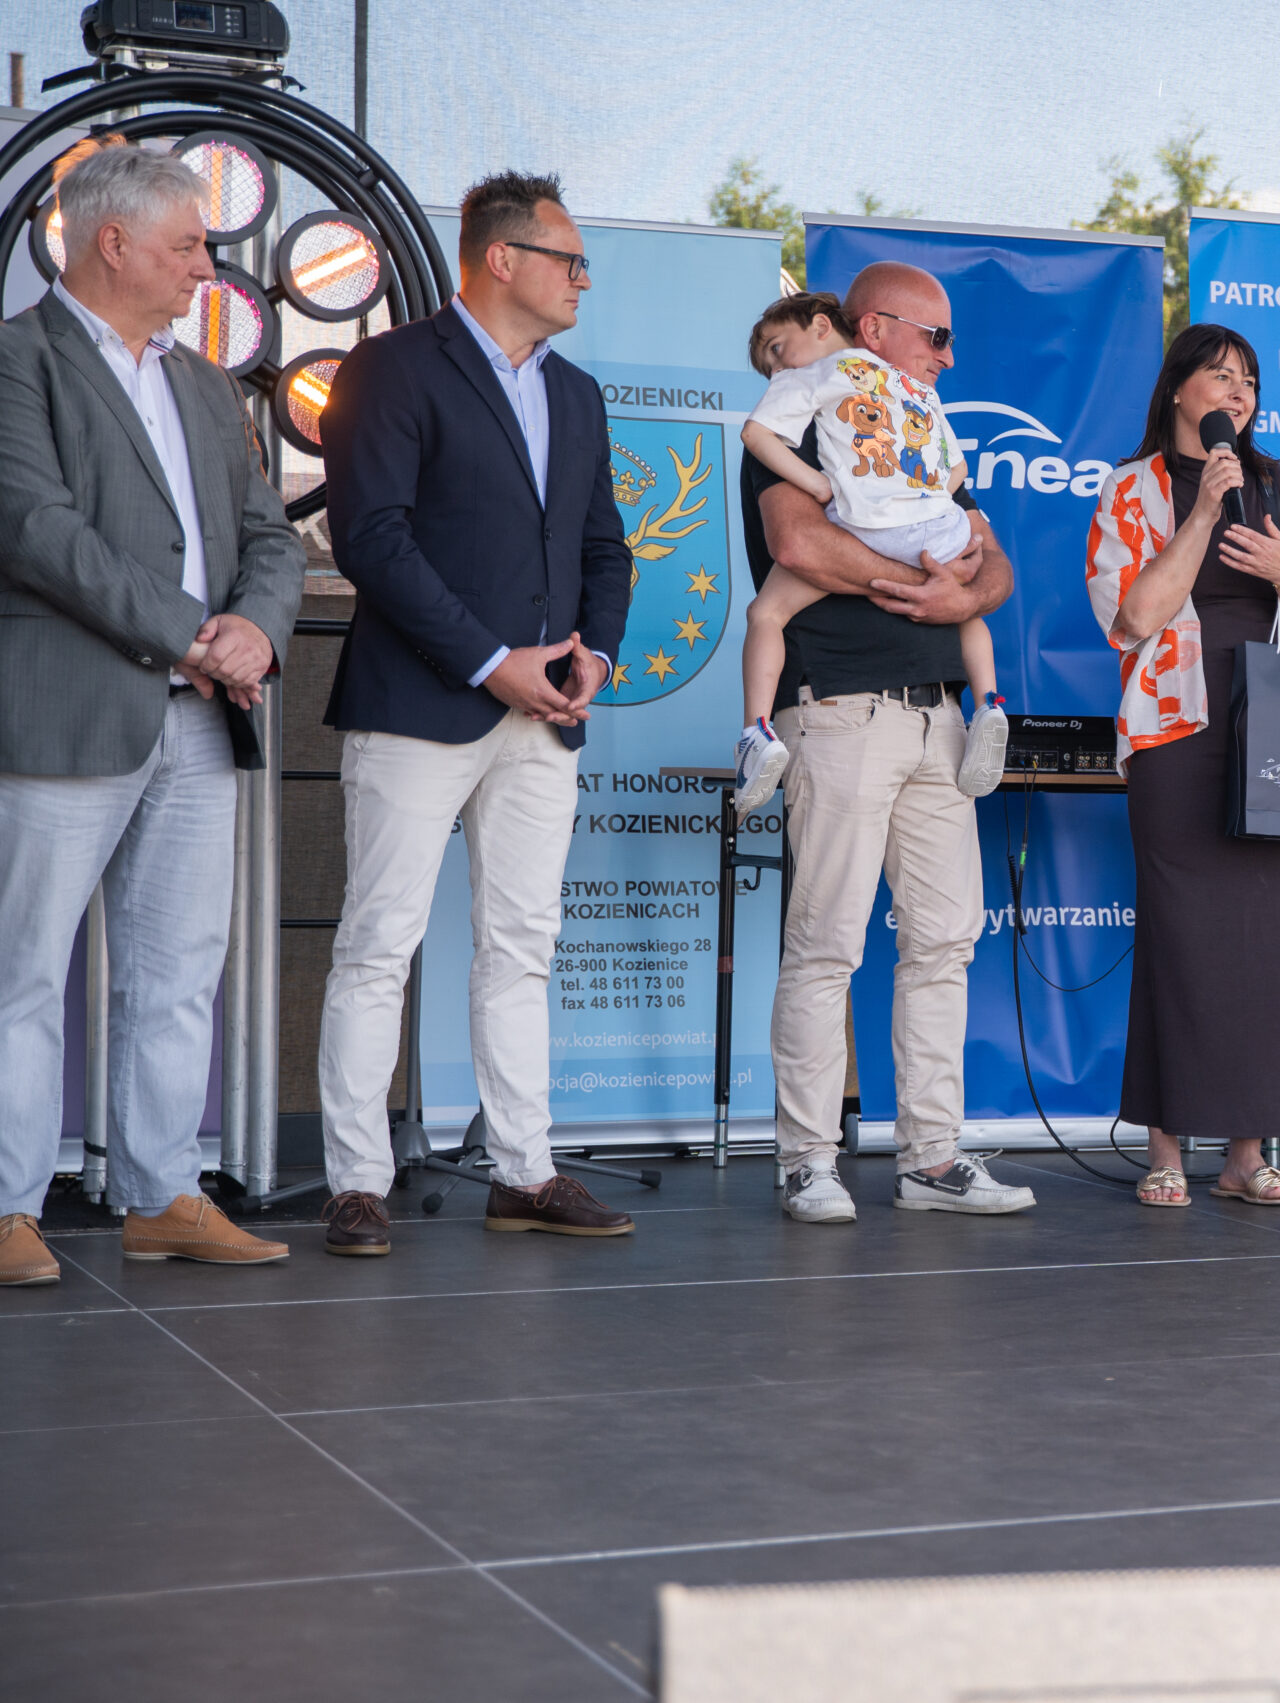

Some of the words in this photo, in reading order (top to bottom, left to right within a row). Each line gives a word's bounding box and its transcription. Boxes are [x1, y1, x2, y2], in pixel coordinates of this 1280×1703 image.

[603, 384, 723, 410] OZIENICKI
[1022, 718, 1068, 728] Pioneer
[561, 881, 618, 897] STWO
[625, 881, 747, 897] POWIATOE
[564, 903, 699, 919] KOZIENICACH
[555, 940, 689, 955] Kochanowskiego
[694, 939, 711, 952] 28
[555, 959, 607, 972] 26-900
[613, 958, 688, 971] Kozienice
[561, 978, 585, 991] tel.
[589, 977, 608, 990] 48
[613, 977, 639, 990] 611
[645, 976, 662, 989] 73
[666, 976, 684, 989] 00
[561, 996, 585, 1010] fax
[590, 996, 608, 1009] 48
[613, 995, 639, 1008] 611
[645, 995, 662, 1008] 73
[667, 995, 685, 1008] 06
